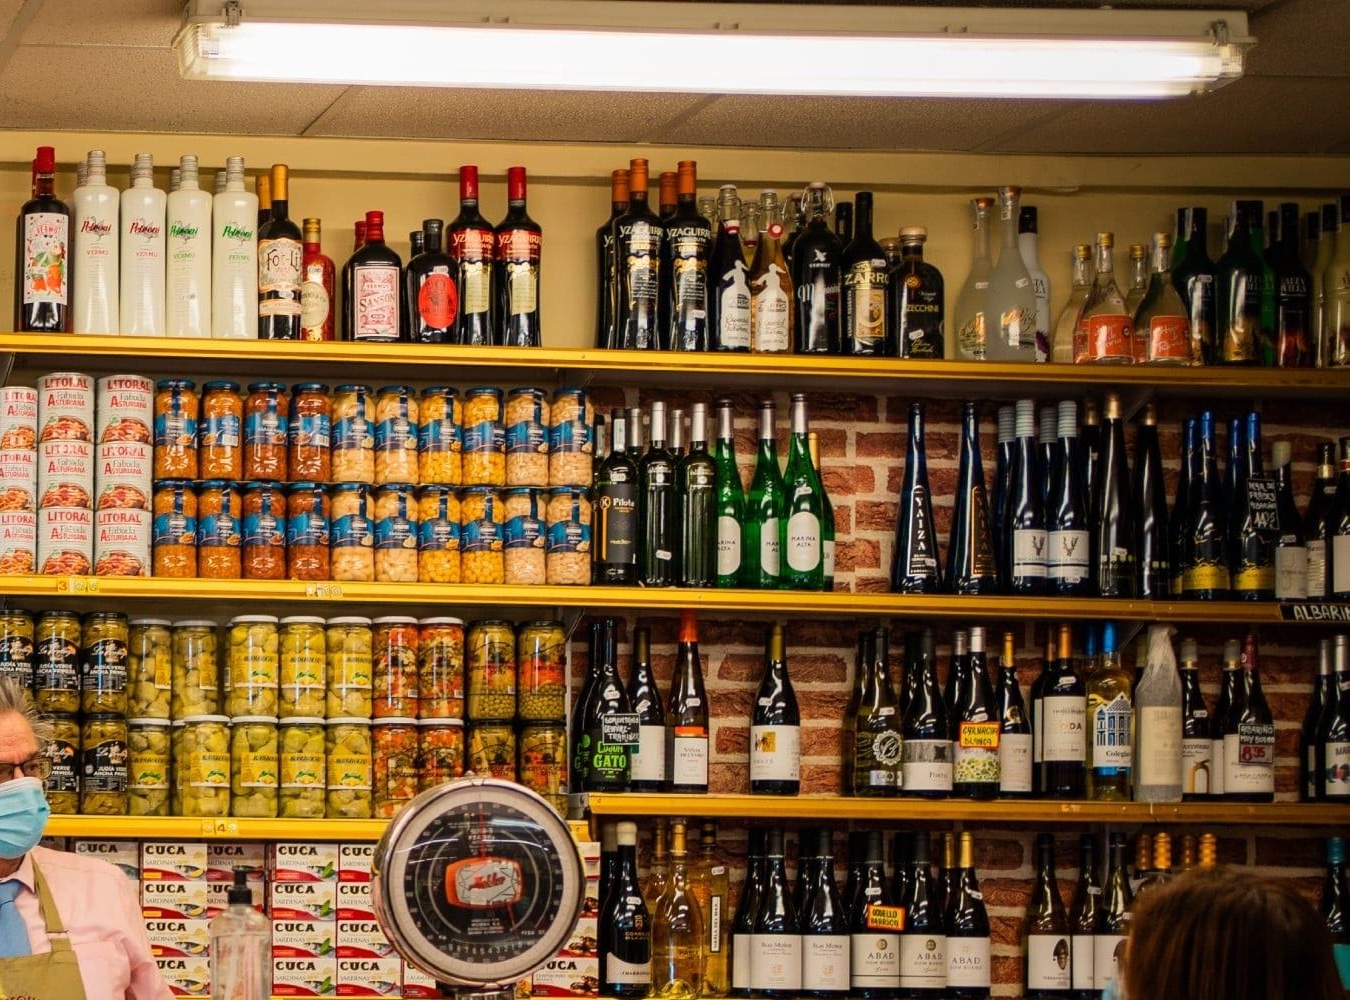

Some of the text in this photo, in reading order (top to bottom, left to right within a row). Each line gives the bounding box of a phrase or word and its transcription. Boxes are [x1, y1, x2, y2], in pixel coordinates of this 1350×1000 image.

[108, 380, 150, 390] LITORAL
[48, 512, 90, 522] LITORAL
[99, 514, 141, 523] LITORAL
[915, 497, 926, 551] YAIZA
[593, 755, 626, 768] GATO
[78, 844, 118, 853] CUCA
[145, 845, 186, 855] CUCA
[278, 846, 318, 855] CUCA
[145, 884, 186, 893] CUCA
[275, 885, 314, 894] CUCA
[146, 922, 186, 932] CUCA
[275, 923, 315, 932] CUCA
[340, 923, 379, 933] CUCA
[866, 952, 896, 961] ABAD
[916, 952, 944, 961] ABAD
[951, 956, 982, 965] ABAD
[276, 961, 316, 971] CUCA
[340, 961, 379, 971] CUCA
